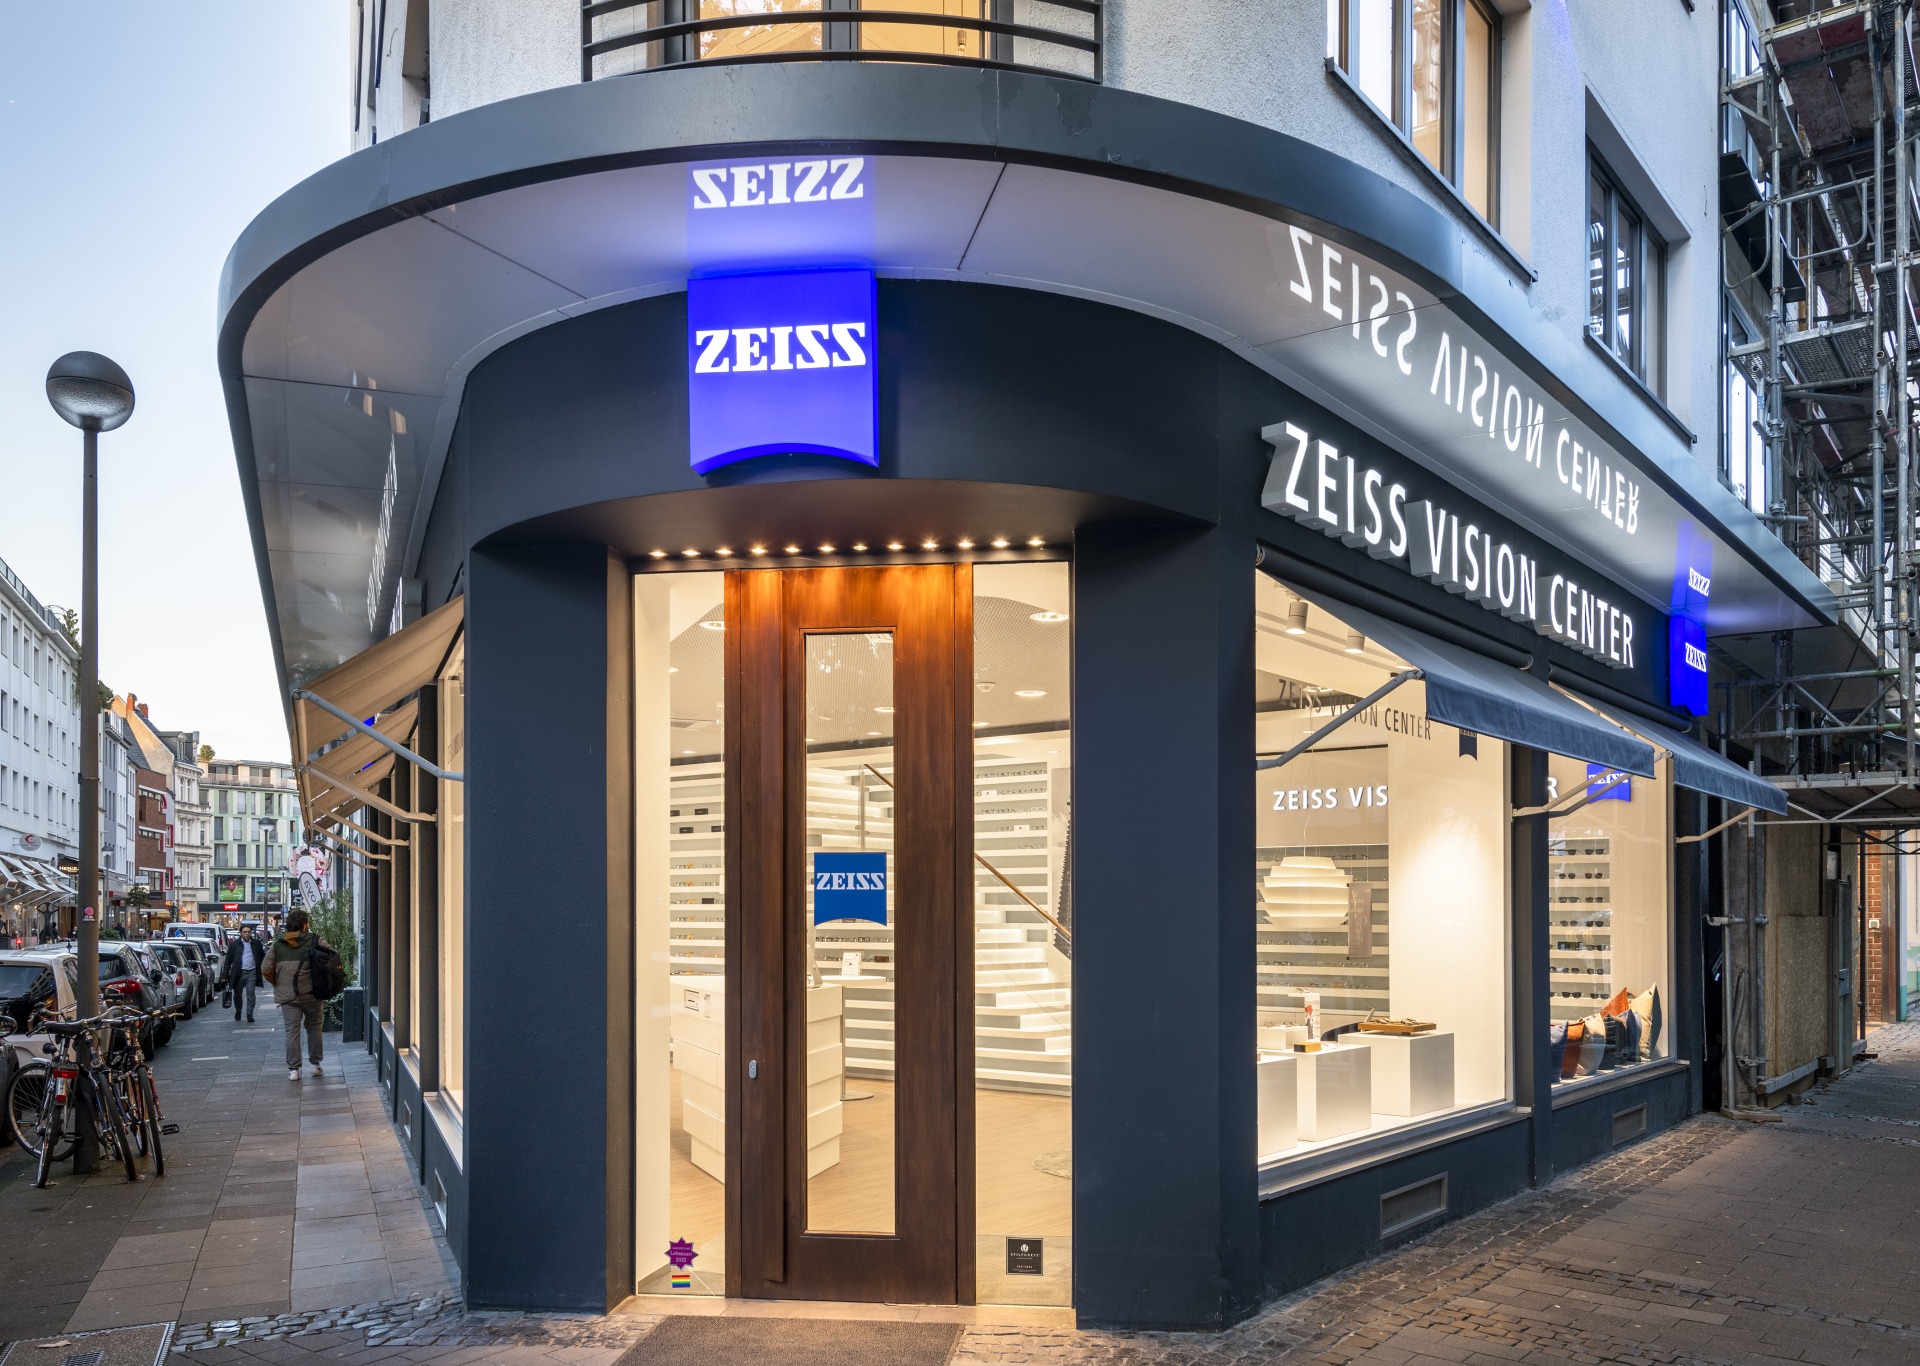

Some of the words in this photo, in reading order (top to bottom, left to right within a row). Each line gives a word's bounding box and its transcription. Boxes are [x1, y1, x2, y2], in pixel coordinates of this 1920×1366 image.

[694, 322, 867, 374] ZEISS
[1280, 421, 1406, 558] ZEISS
[1422, 500, 1536, 621] VISION
[1548, 575, 1634, 669] CENTER
[1685, 642, 1707, 673] ZEISS
[1385, 707, 1431, 740] CENTER
[1273, 788, 1338, 811] ZEISS
[816, 872, 885, 890] ZEISS
